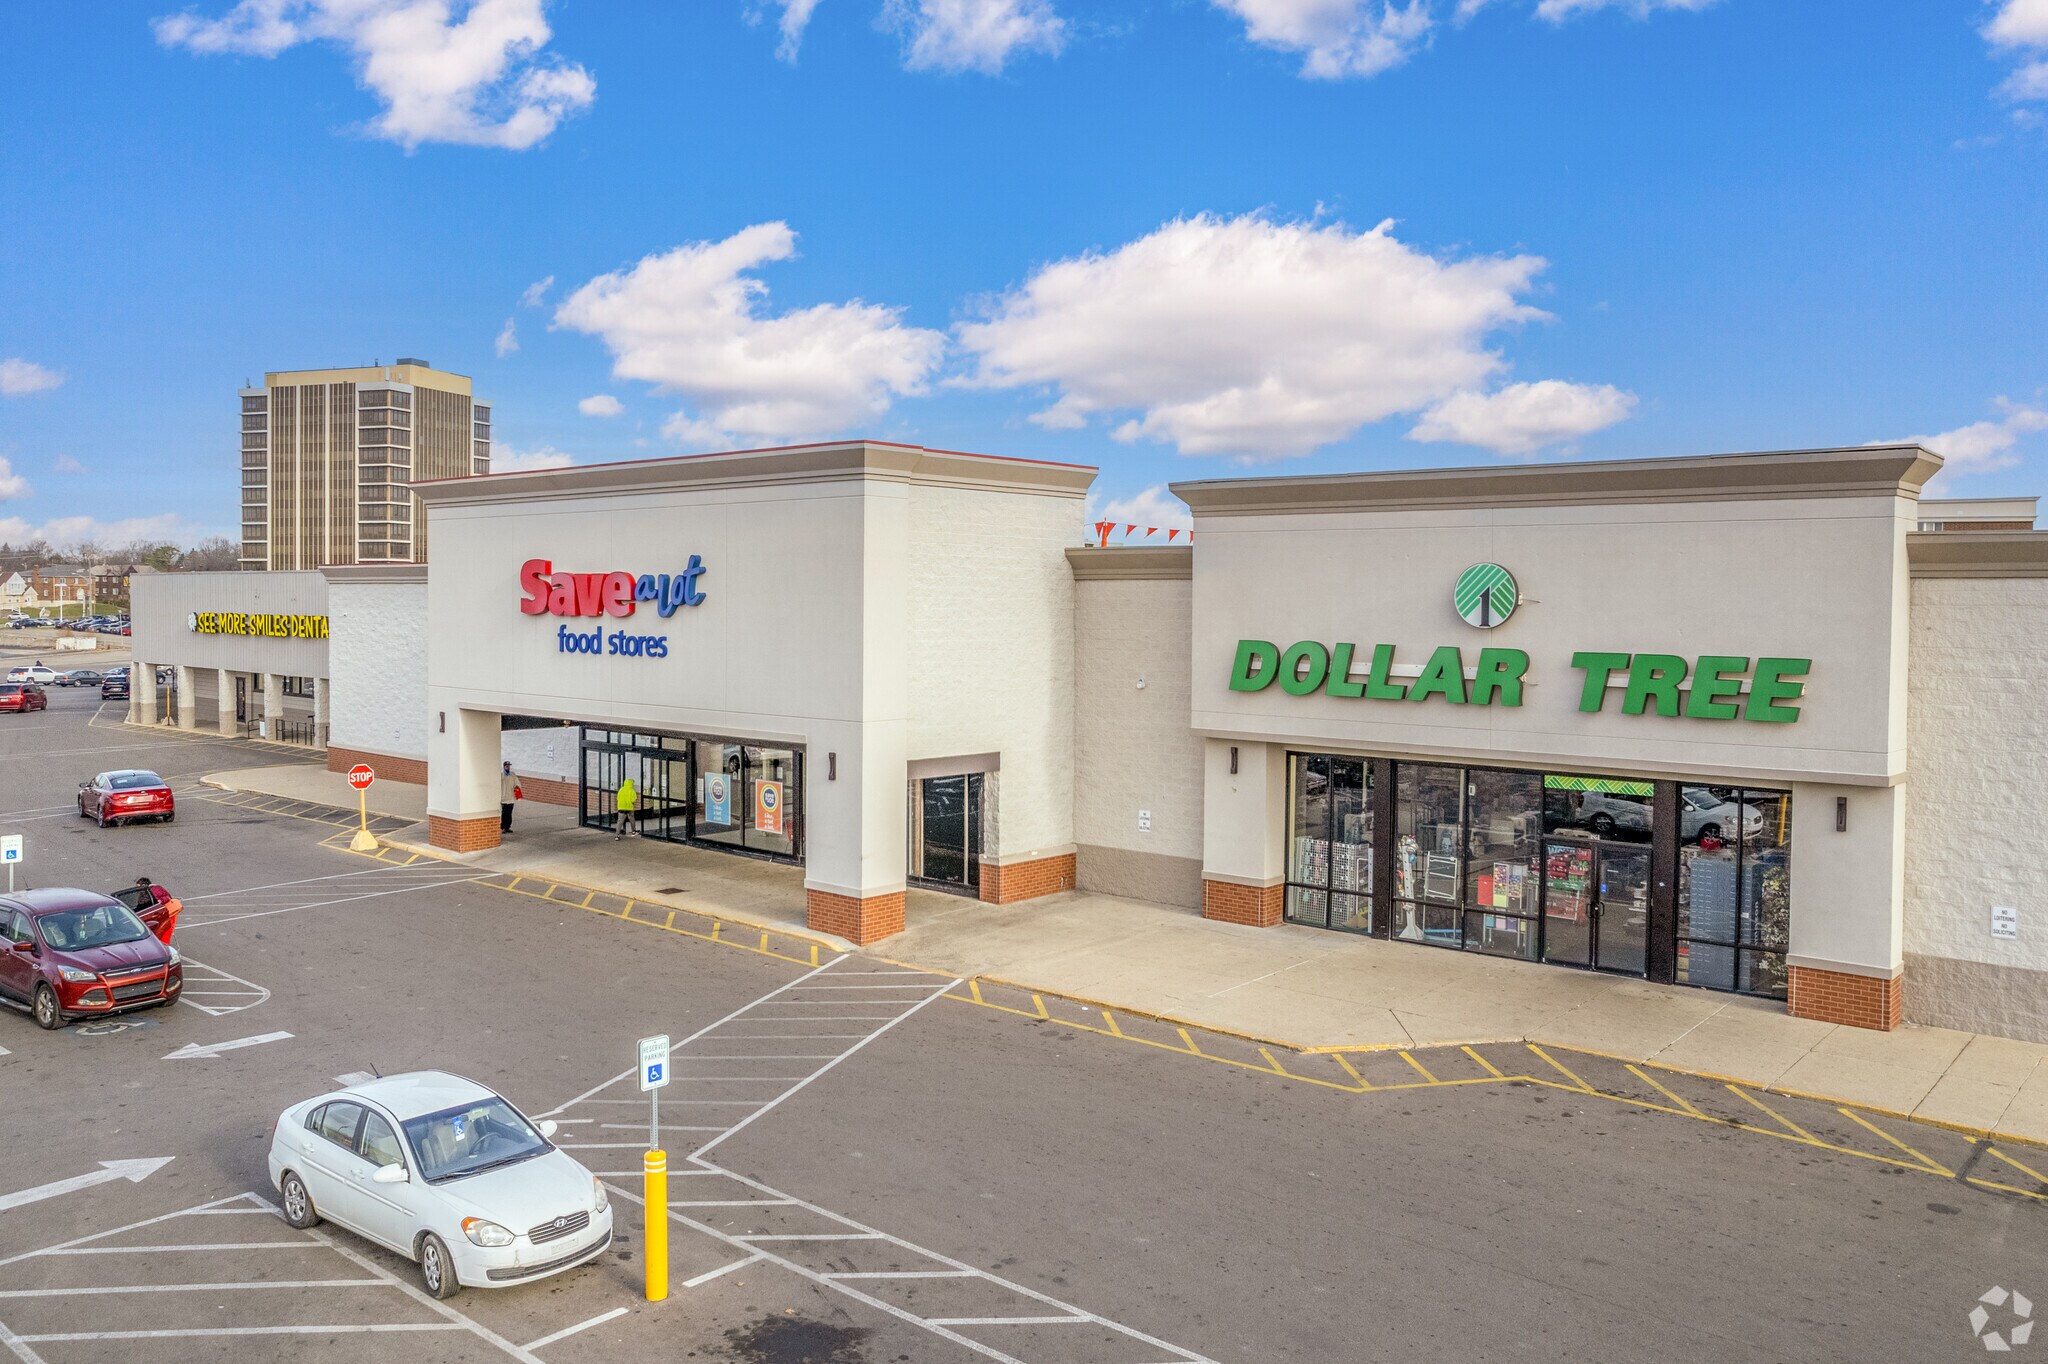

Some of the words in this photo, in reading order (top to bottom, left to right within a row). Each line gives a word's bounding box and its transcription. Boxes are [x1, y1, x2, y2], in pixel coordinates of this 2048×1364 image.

[520, 558, 636, 618] Save
[198, 612, 217, 633] SEE
[219, 612, 248, 635] MORE
[249, 614, 290, 637] SMILES
[557, 624, 602, 654] food
[608, 630, 668, 657] stores
[1229, 639, 1530, 706] DOLLAR
[1571, 651, 1812, 723] TREE
[350, 771, 372, 783] STOP
[1993, 928, 2016, 936] SOLICITING
[643, 1043, 667, 1053] RESERVED
[644, 1051, 666, 1061] PARKING
